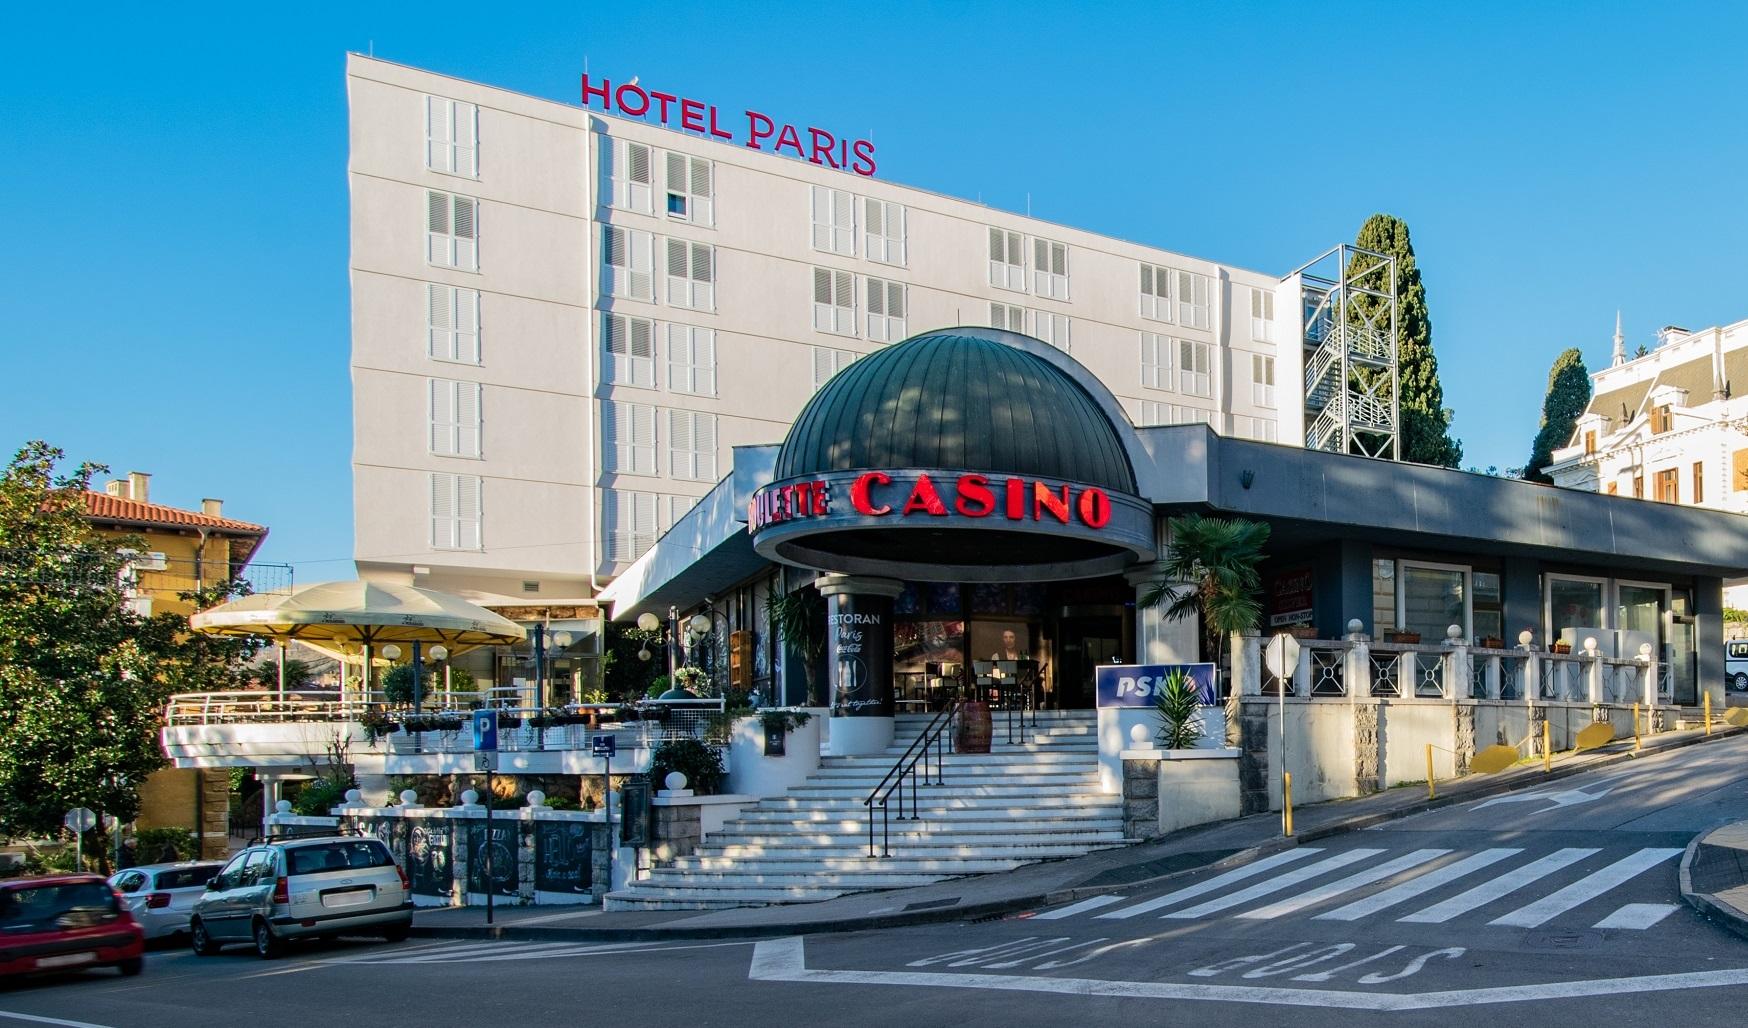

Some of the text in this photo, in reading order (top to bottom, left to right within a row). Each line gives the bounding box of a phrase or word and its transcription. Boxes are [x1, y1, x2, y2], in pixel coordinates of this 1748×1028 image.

[581, 72, 877, 177] HOTEL PARIS
[850, 472, 1112, 529] CASINO
[480, 717, 490, 743] P
[905, 936, 1153, 971] STOP
[1186, 941, 1467, 985] STOP
